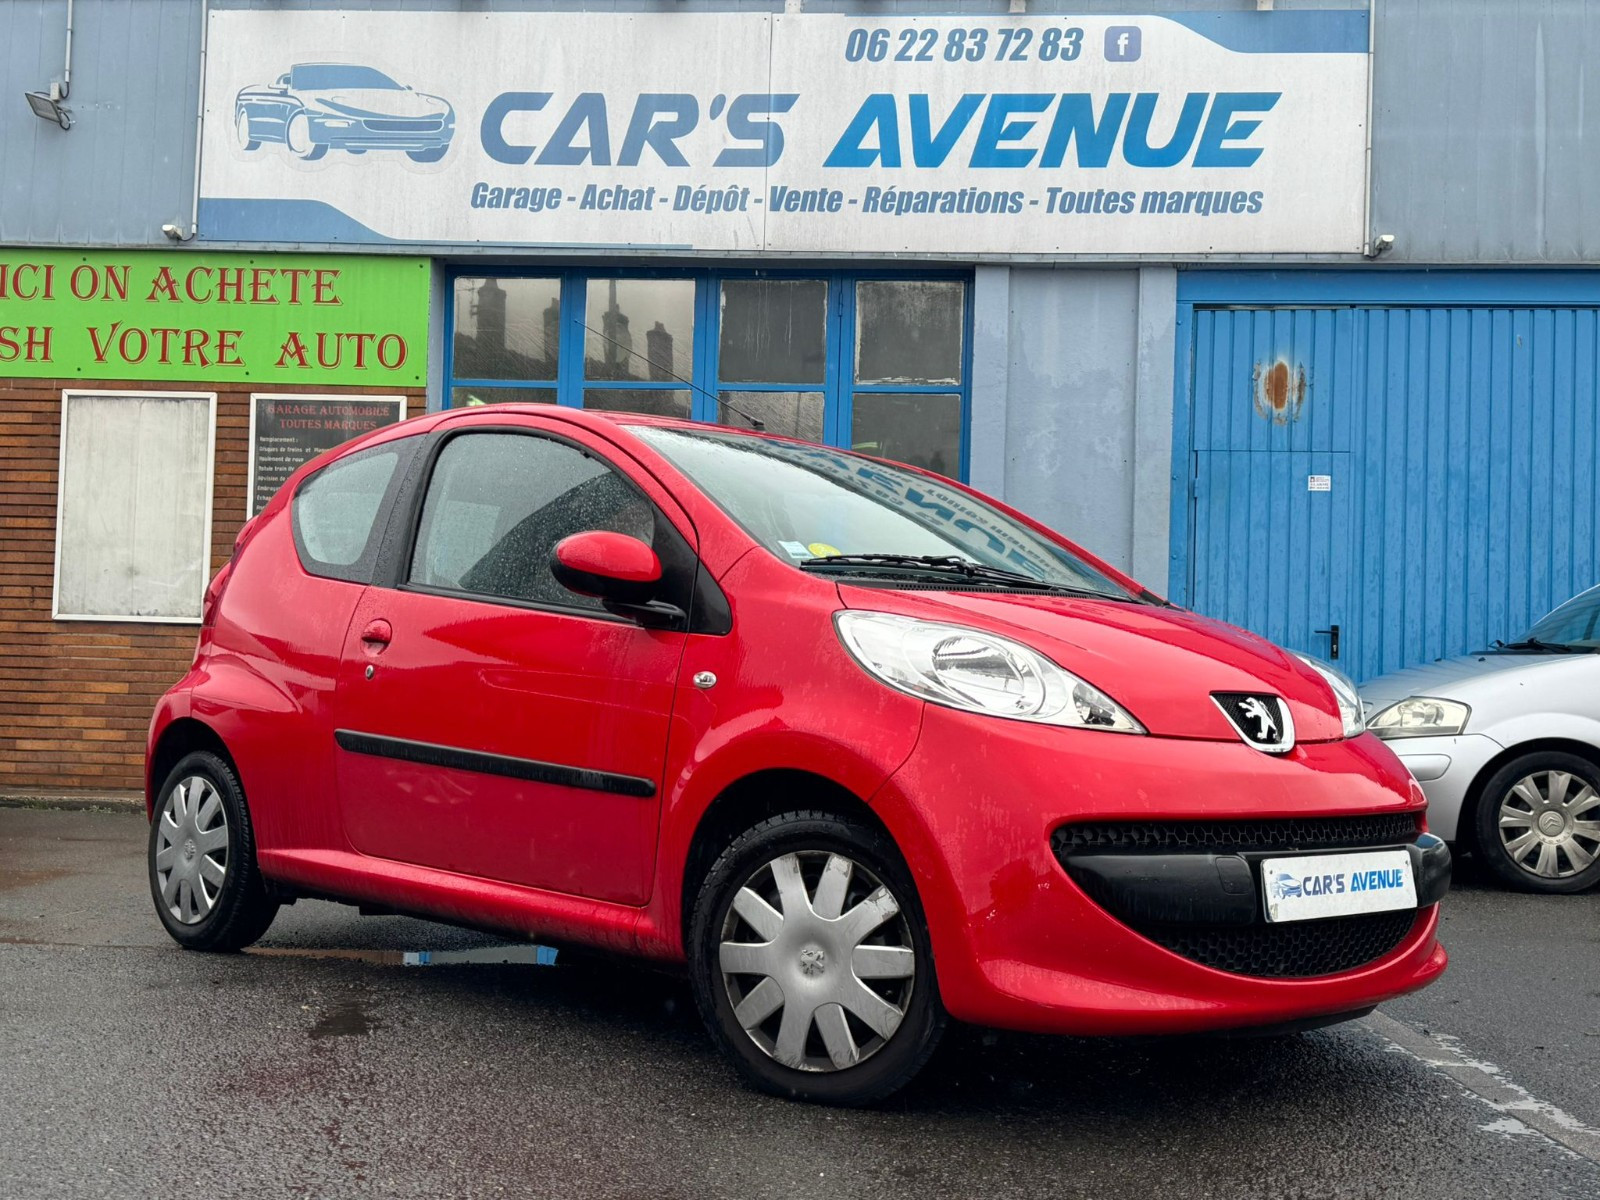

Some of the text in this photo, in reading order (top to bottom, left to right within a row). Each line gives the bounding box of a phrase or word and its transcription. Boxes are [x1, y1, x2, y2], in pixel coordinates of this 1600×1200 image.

[845, 27, 1084, 62] 06 22 83 72 83
[480, 91, 1283, 168] CAR'S AVENUE
[470, 181, 562, 213] Garage
[579, 184, 656, 211] Achat
[672, 184, 750, 214] Dépôt
[769, 185, 844, 213] Vente
[862, 185, 1025, 216] Réparations
[1045, 187, 1136, 214] Toutes
[1140, 190, 1264, 217] marques
[0, 264, 343, 306] ICI ON ACHETE
[0, 320, 408, 371] SH VOTRE AUTO
[266, 404, 390, 416] GARAGE AUTOMOBILE
[280, 419, 377, 430] TOUTES MARQUES
[1302, 869, 1403, 896] CAR'S AVENUE
